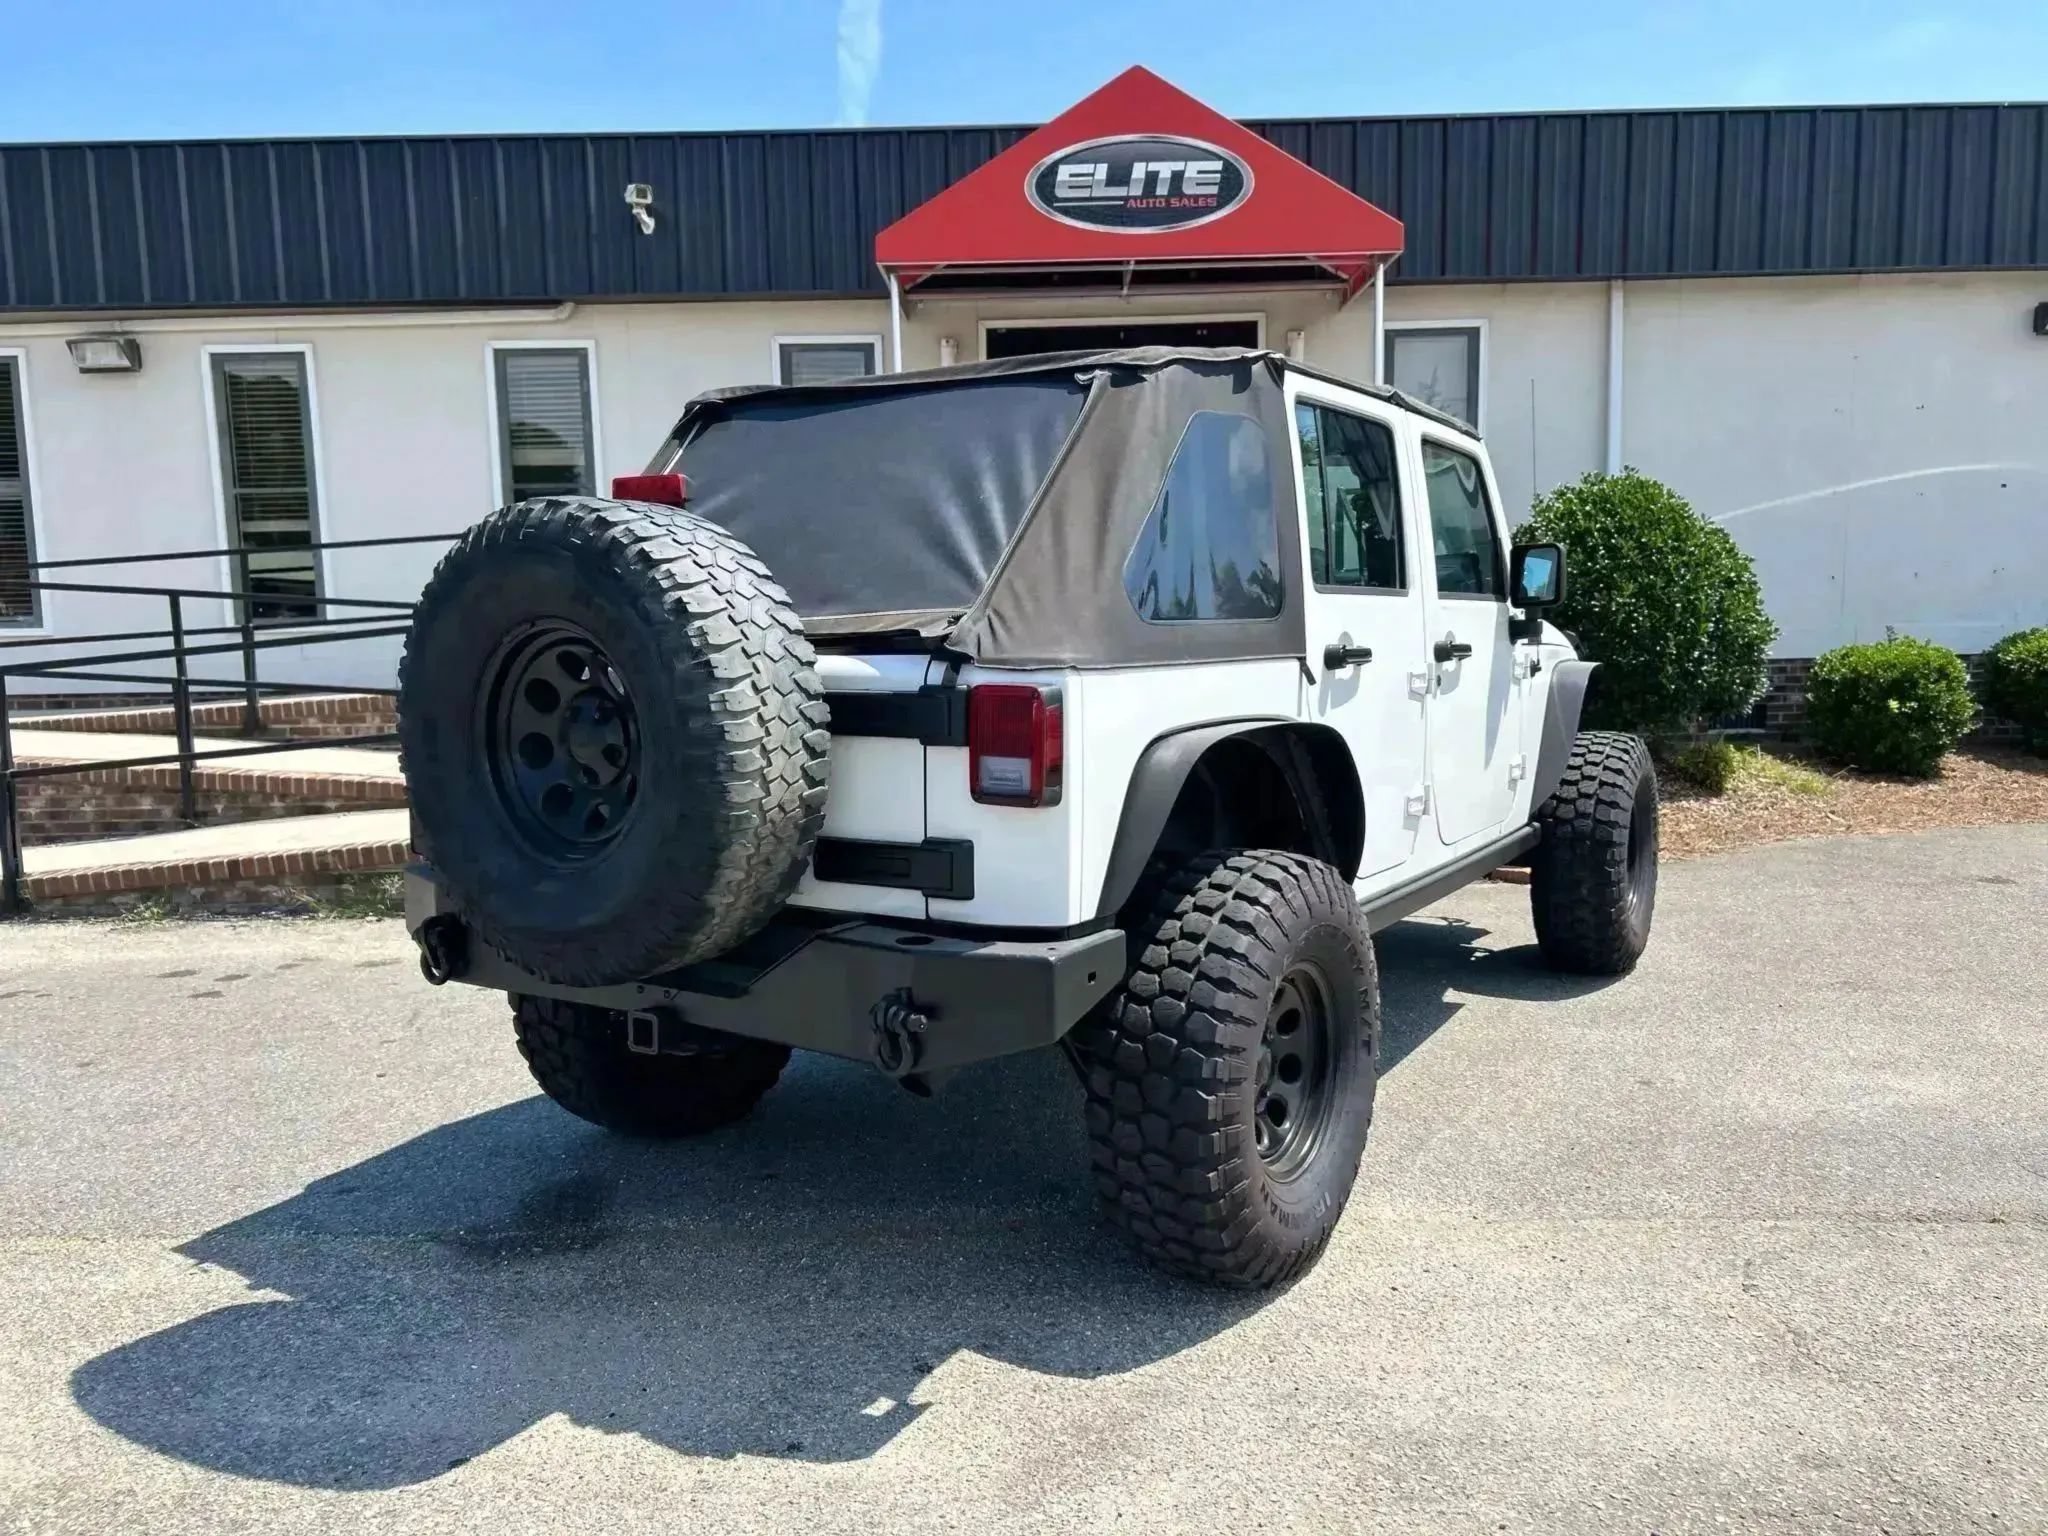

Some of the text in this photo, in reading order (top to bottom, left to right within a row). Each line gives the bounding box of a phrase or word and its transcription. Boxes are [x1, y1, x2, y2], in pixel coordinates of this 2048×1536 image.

[1054, 160, 1224, 198] ELITE
[1126, 197, 1218, 209] AUTO SALES
[1260, 1181, 1331, 1230] IRNMAN
